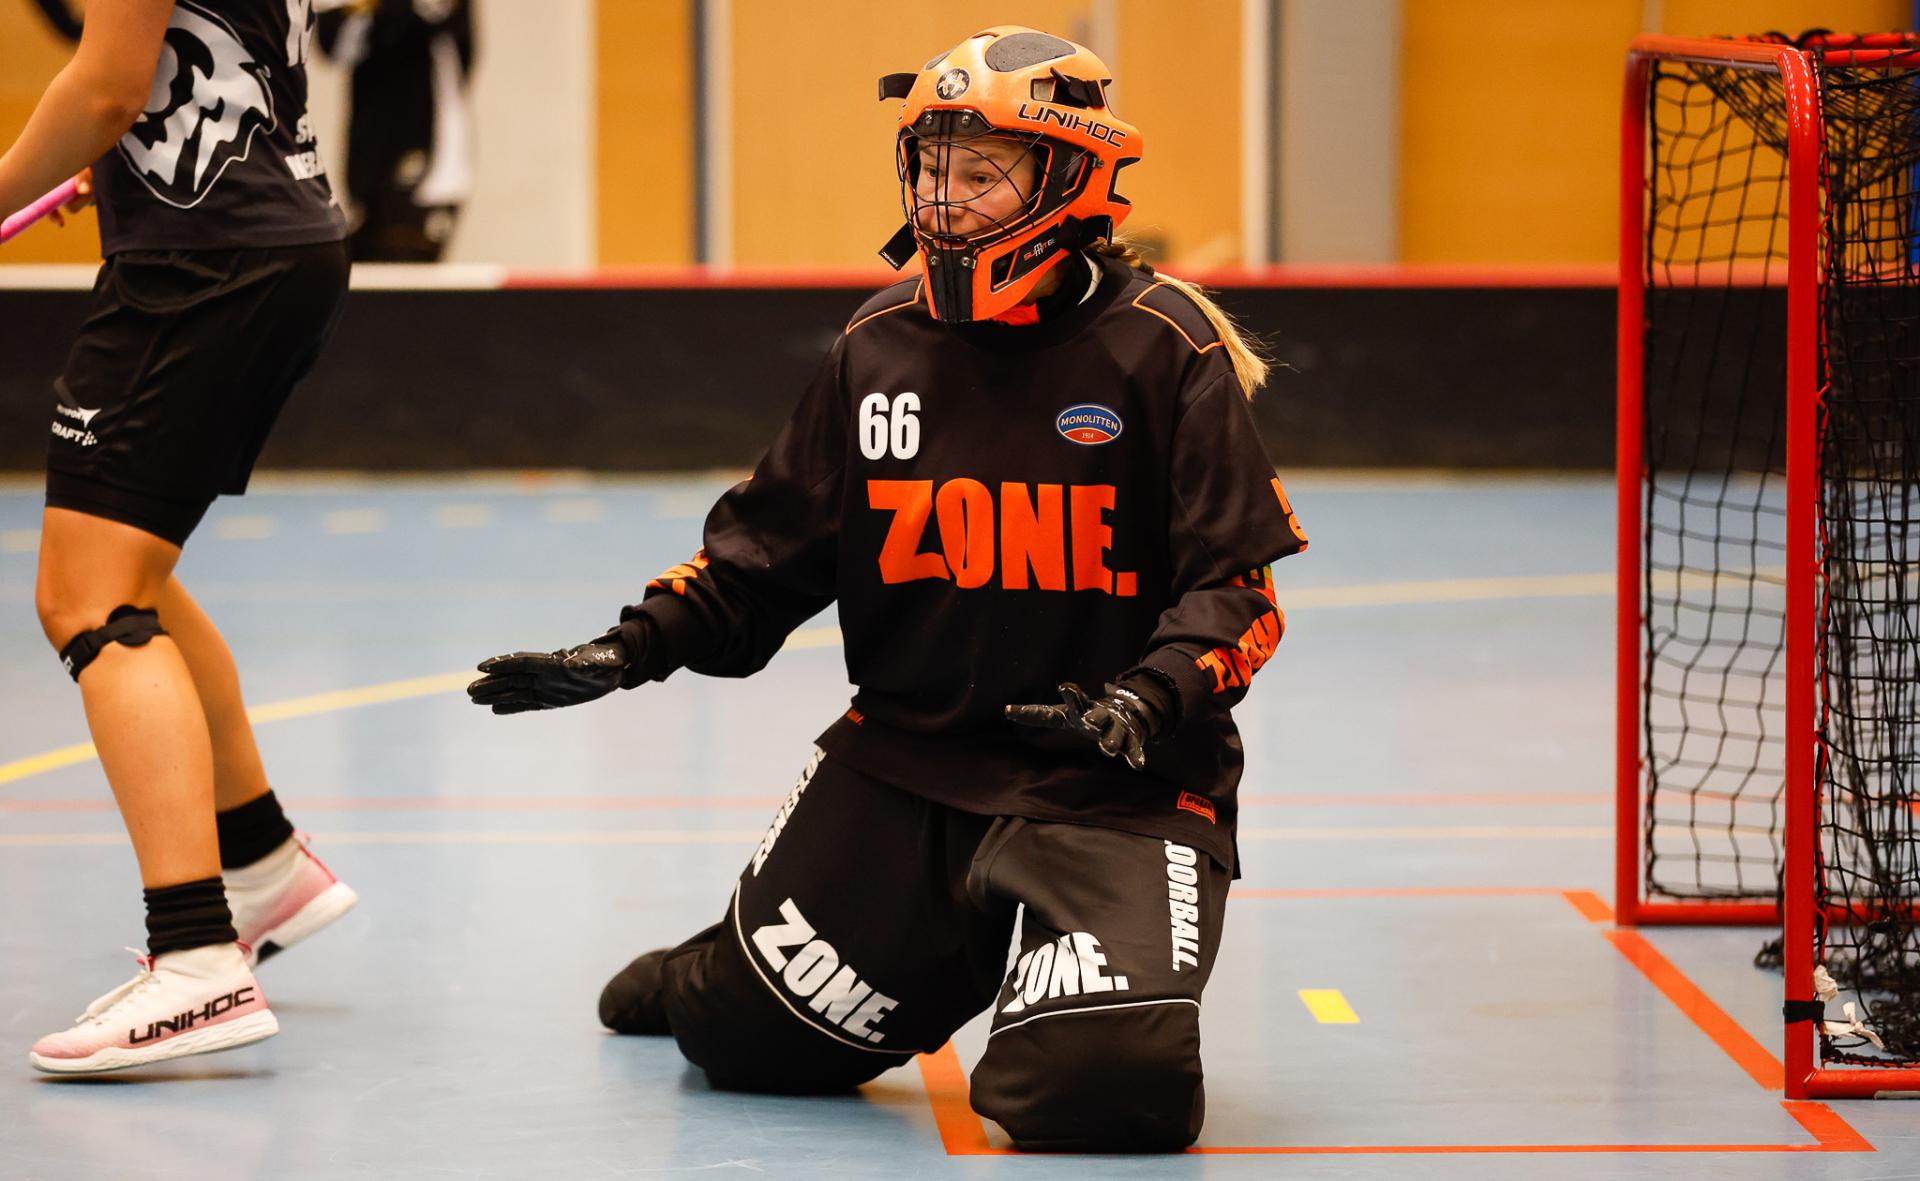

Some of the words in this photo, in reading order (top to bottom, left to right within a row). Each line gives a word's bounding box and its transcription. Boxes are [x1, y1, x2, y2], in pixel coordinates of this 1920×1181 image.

[1017, 103, 1127, 149] UNIHOC
[858, 392, 921, 460] 66
[1060, 414, 1119, 431] MONOLITTEN
[867, 477, 1138, 596] ZONE.
[751, 897, 900, 1044] ZONE.
[129, 986, 255, 1044] UNIHOC
